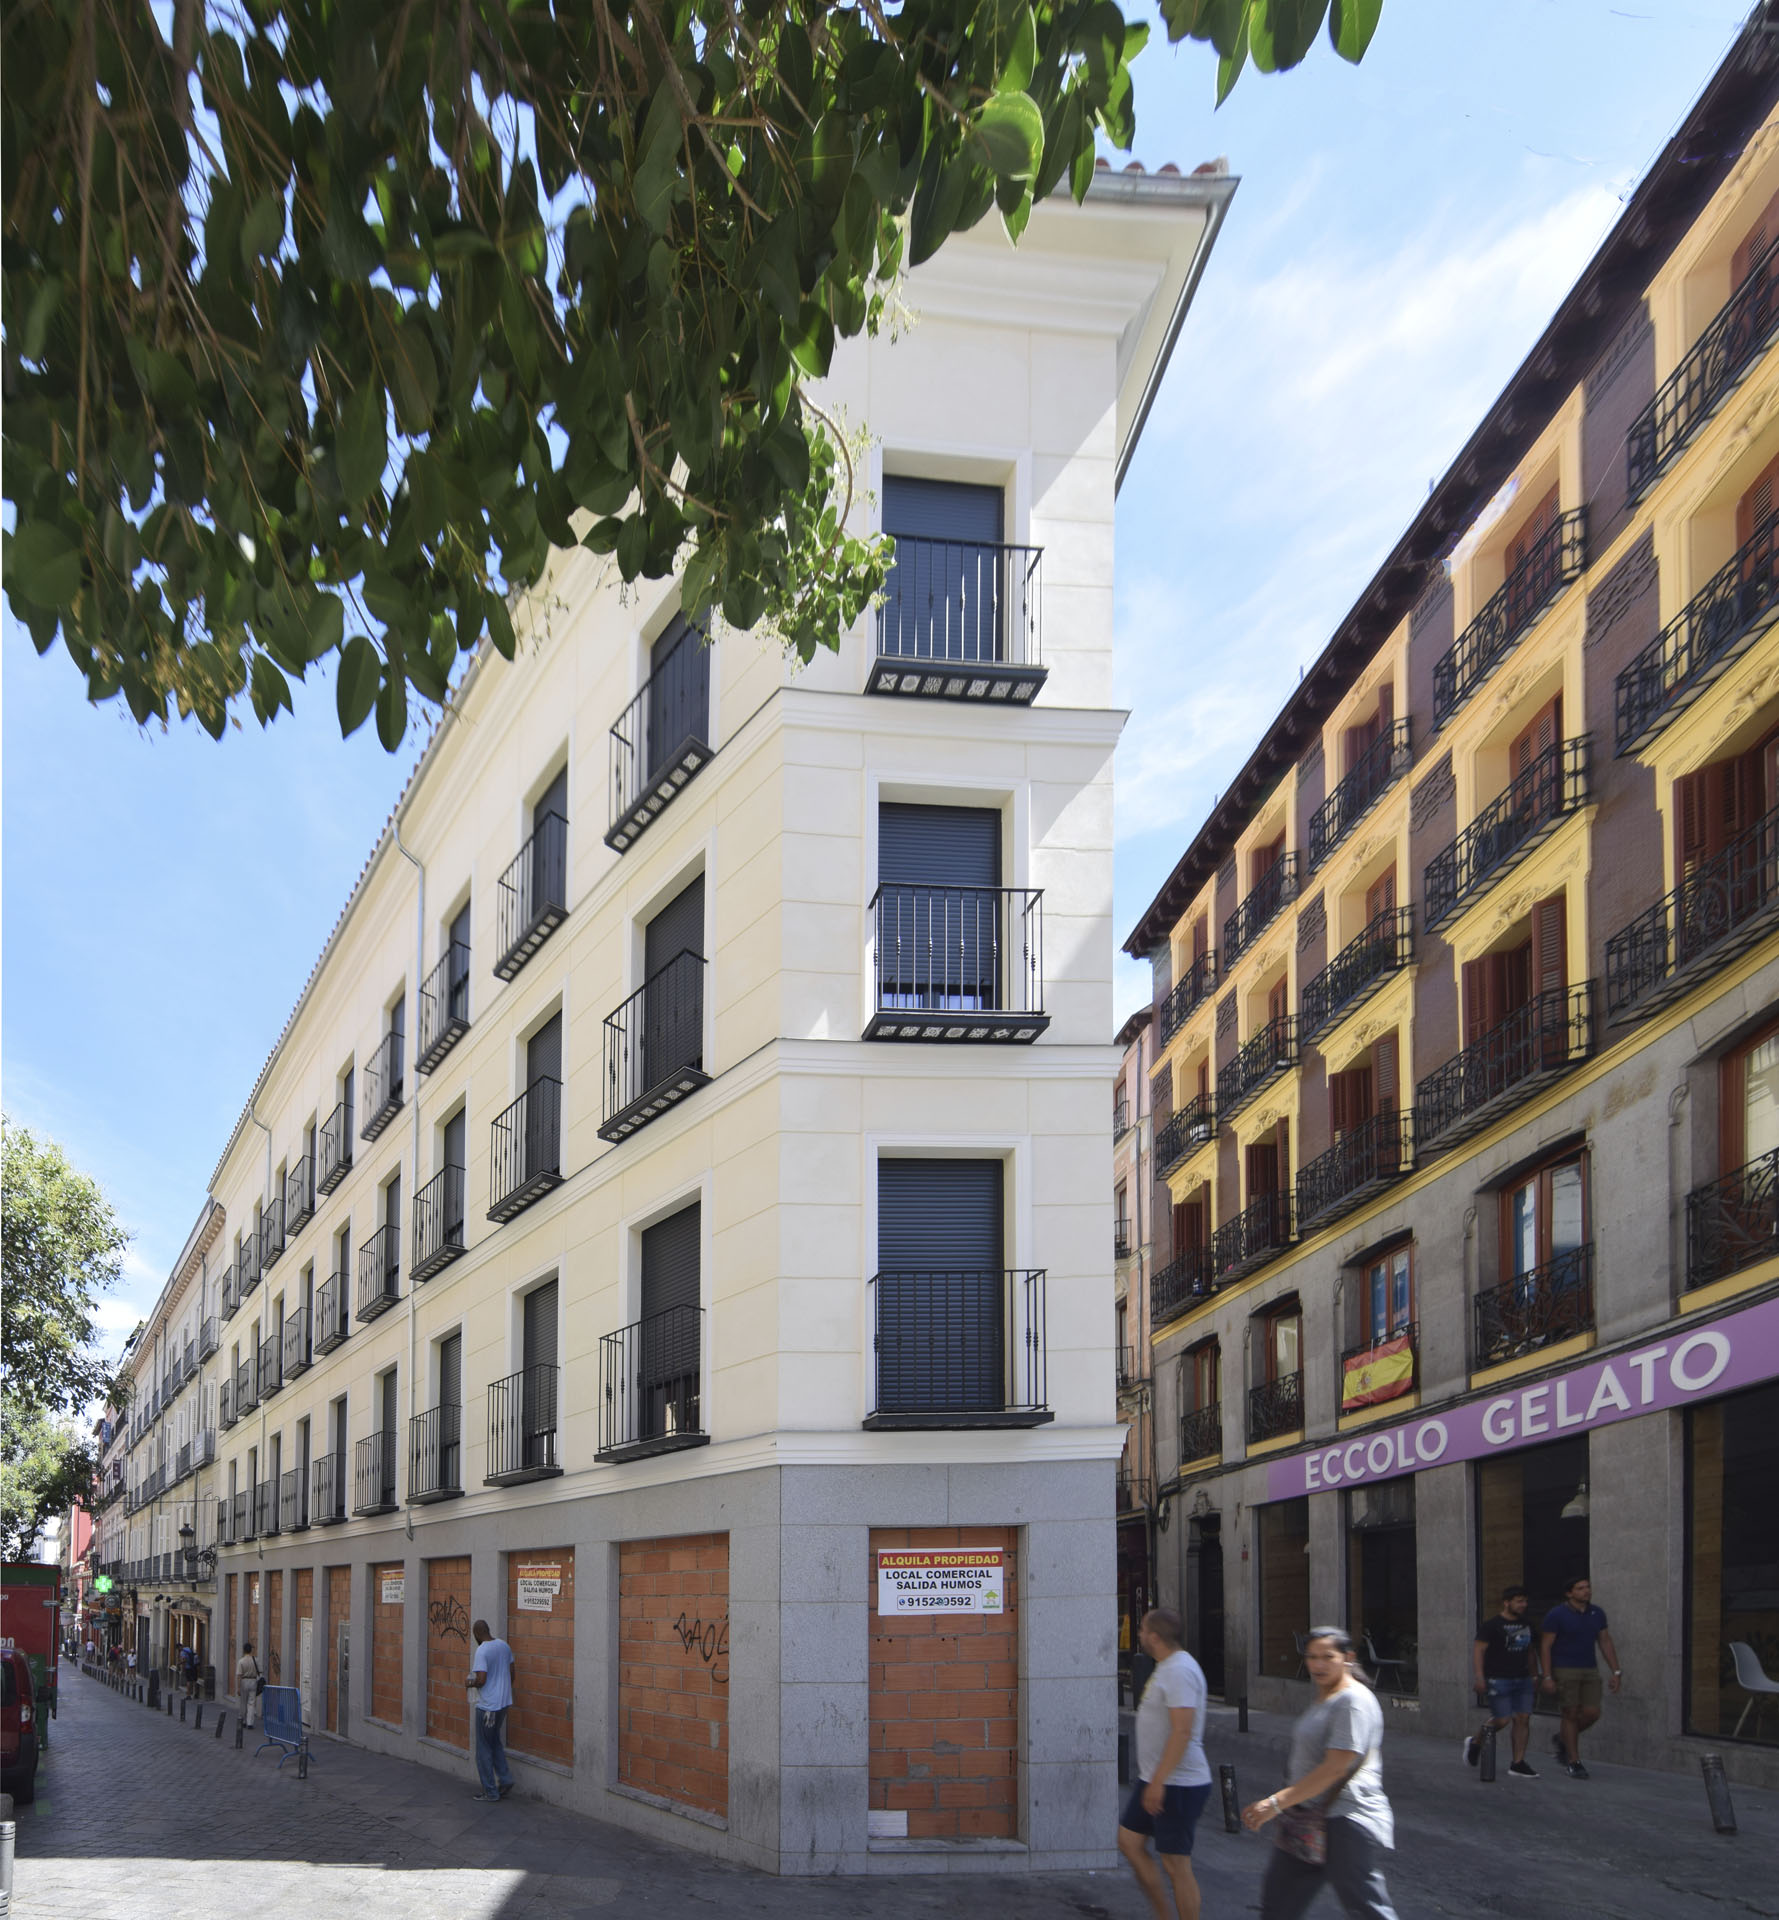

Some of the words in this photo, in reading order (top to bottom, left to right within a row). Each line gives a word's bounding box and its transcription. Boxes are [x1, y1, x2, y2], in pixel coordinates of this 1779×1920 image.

[1304, 1419, 1449, 1490] ECCOLO
[1481, 1330, 1731, 1446] GELATO
[881, 1556, 931, 1566] ALQUILA
[934, 1555, 999, 1565] PROPIEDAD
[885, 1570, 923, 1580] LOCAL
[926, 1569, 993, 1579] COMERCIAL
[896, 1581, 937, 1590] SALIDA
[941, 1580, 982, 1589] HUMOS
